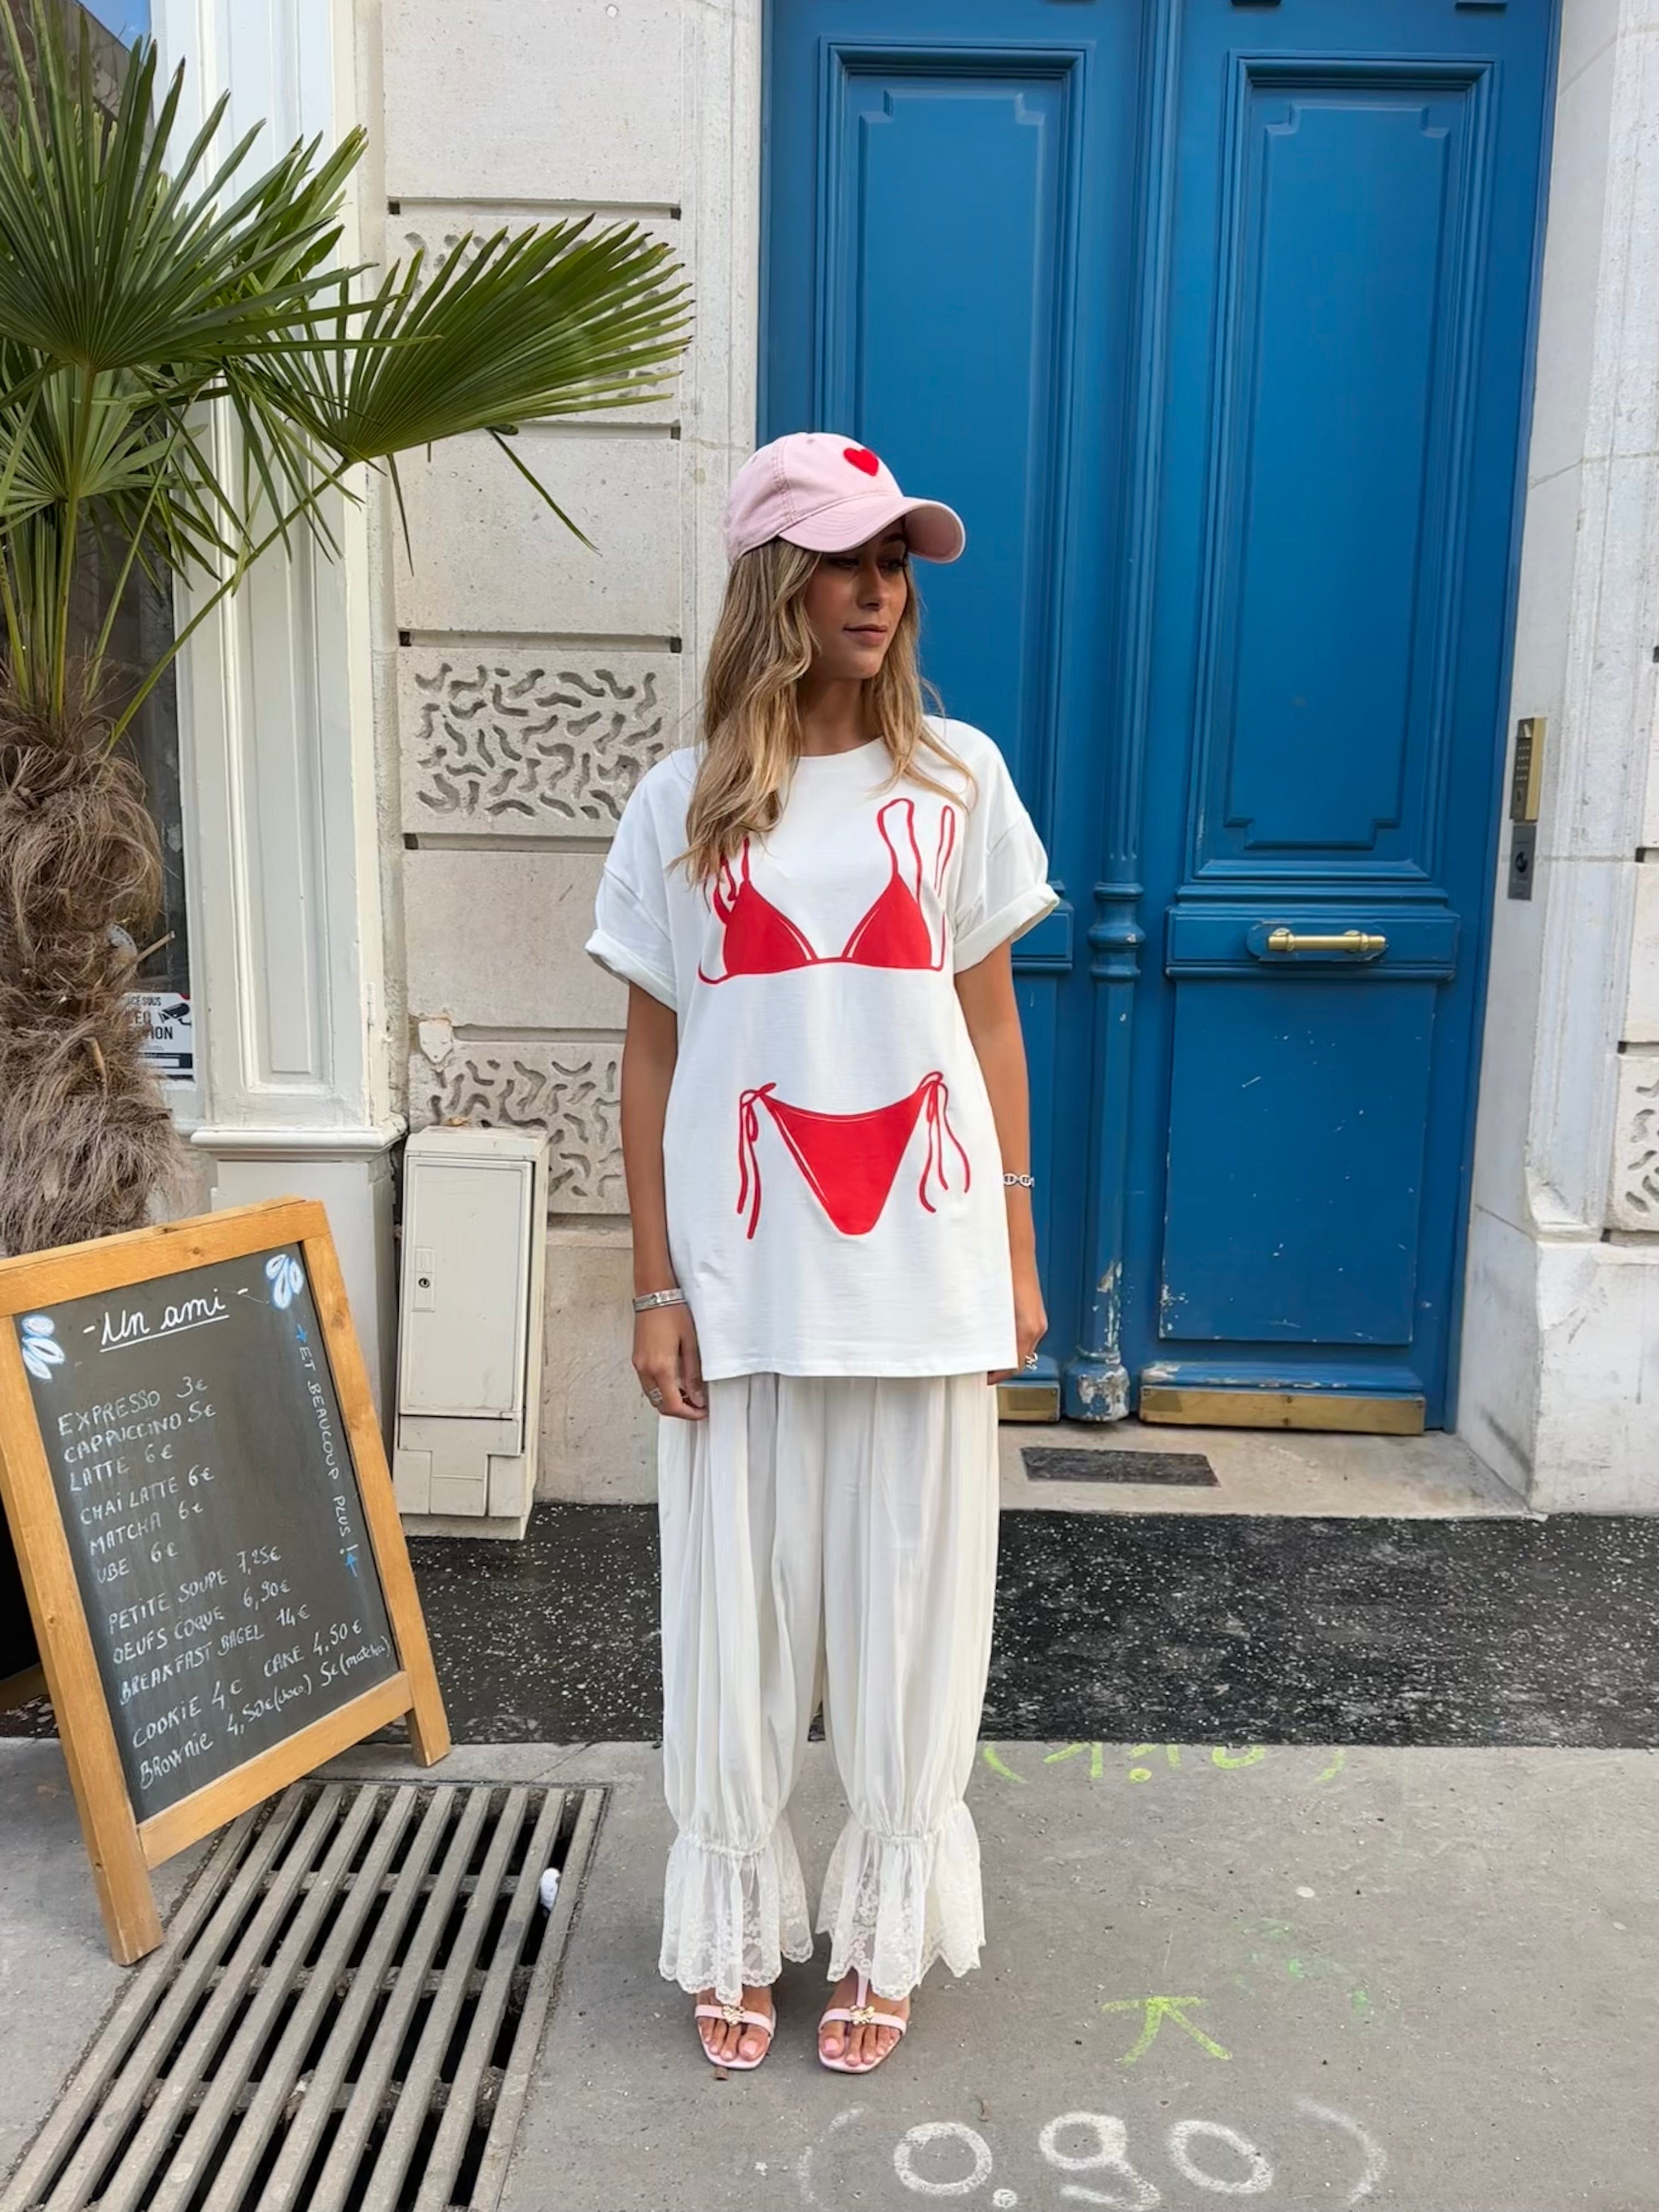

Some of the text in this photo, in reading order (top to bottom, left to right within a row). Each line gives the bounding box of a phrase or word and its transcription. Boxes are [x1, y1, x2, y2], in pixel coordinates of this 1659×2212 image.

[100, 1310, 150, 1346] Un
[160, 1288, 227, 1330] ami
[298, 1346, 317, 1371] ET
[58, 1389, 161, 1437] EXPRESSO
[307, 1380, 340, 1480] BEAUCOUP
[70, 1456, 130, 1492] LATTE
[129, 1476, 179, 1508] LATTE
[89, 1511, 162, 1556] MATCHA
[333, 1495, 352, 1537] PLUS
[96, 1558, 130, 1584] UBE
[178, 1568, 228, 1604] SOUPE
[112, 1627, 168, 1665] OEUFS
[174, 1605, 225, 1640] COQUE
[217, 1624, 266, 1656] BAGEL
[263, 1645, 304, 1678] CAKE
